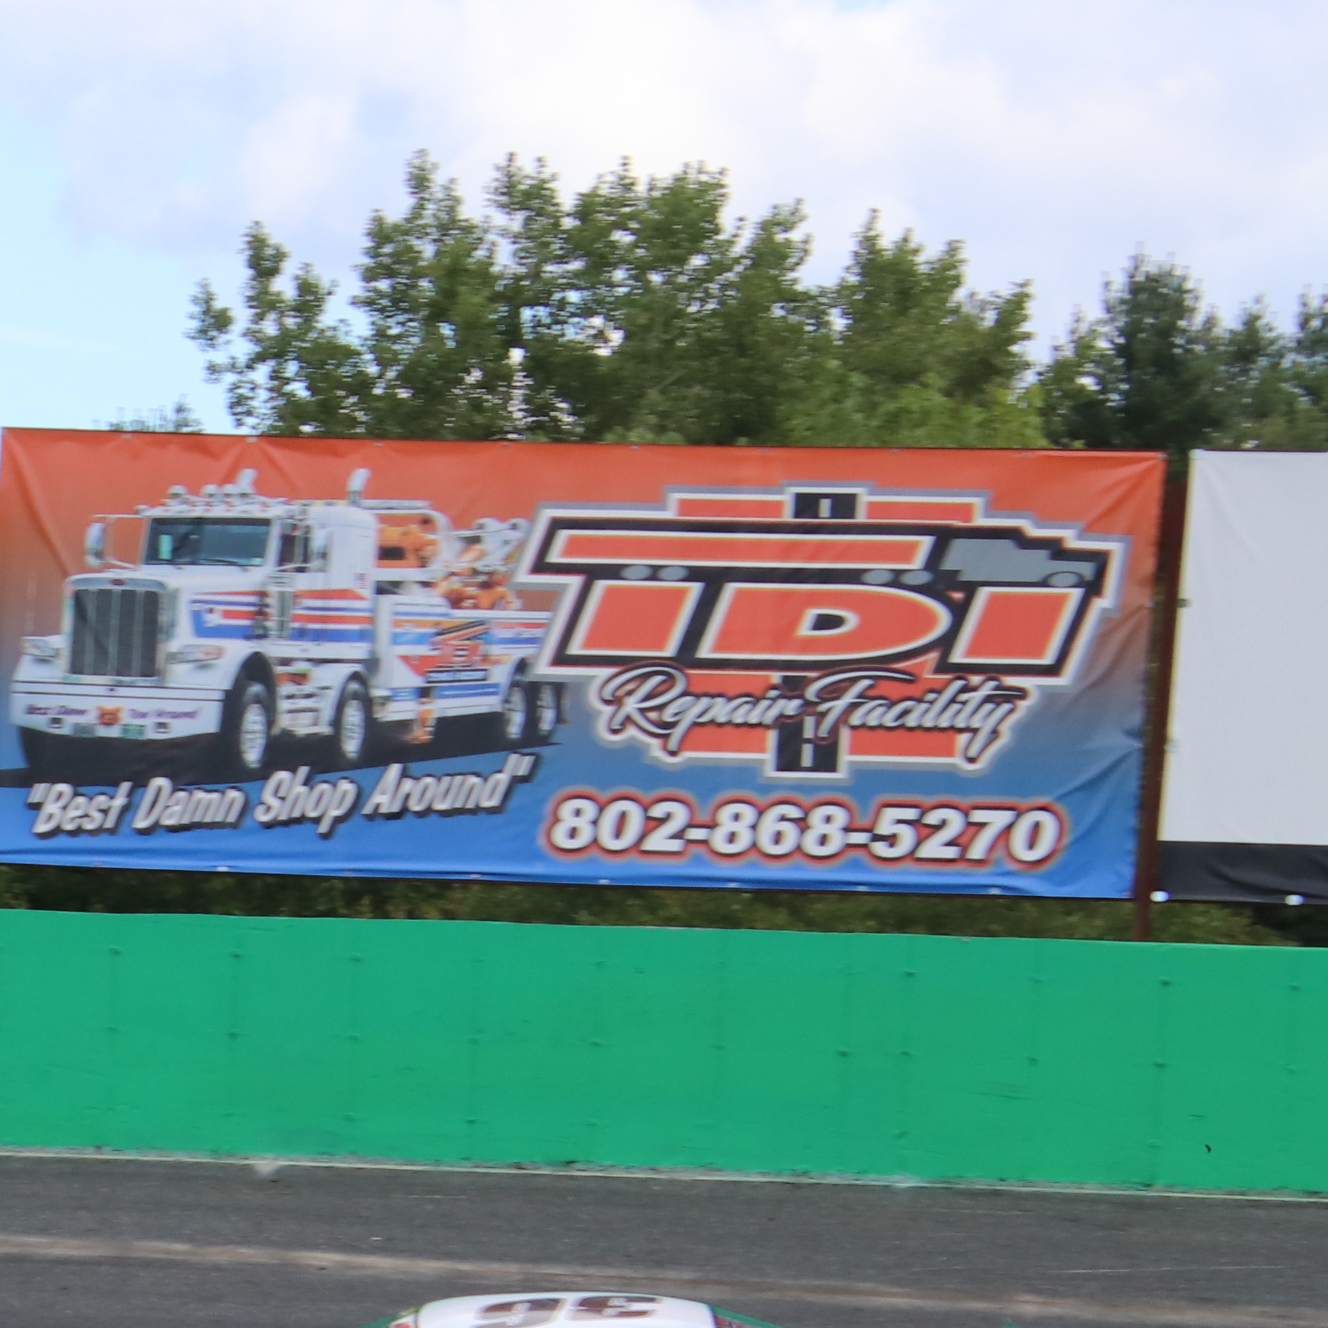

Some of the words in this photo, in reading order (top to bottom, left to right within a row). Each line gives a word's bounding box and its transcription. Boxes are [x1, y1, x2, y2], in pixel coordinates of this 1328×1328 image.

[600, 662, 800, 755] Repair
[807, 670, 1020, 764] Facility
[133, 777, 243, 829] Damn
[254, 766, 358, 837] Shop
[549, 797, 1060, 864] 802-868-5270
